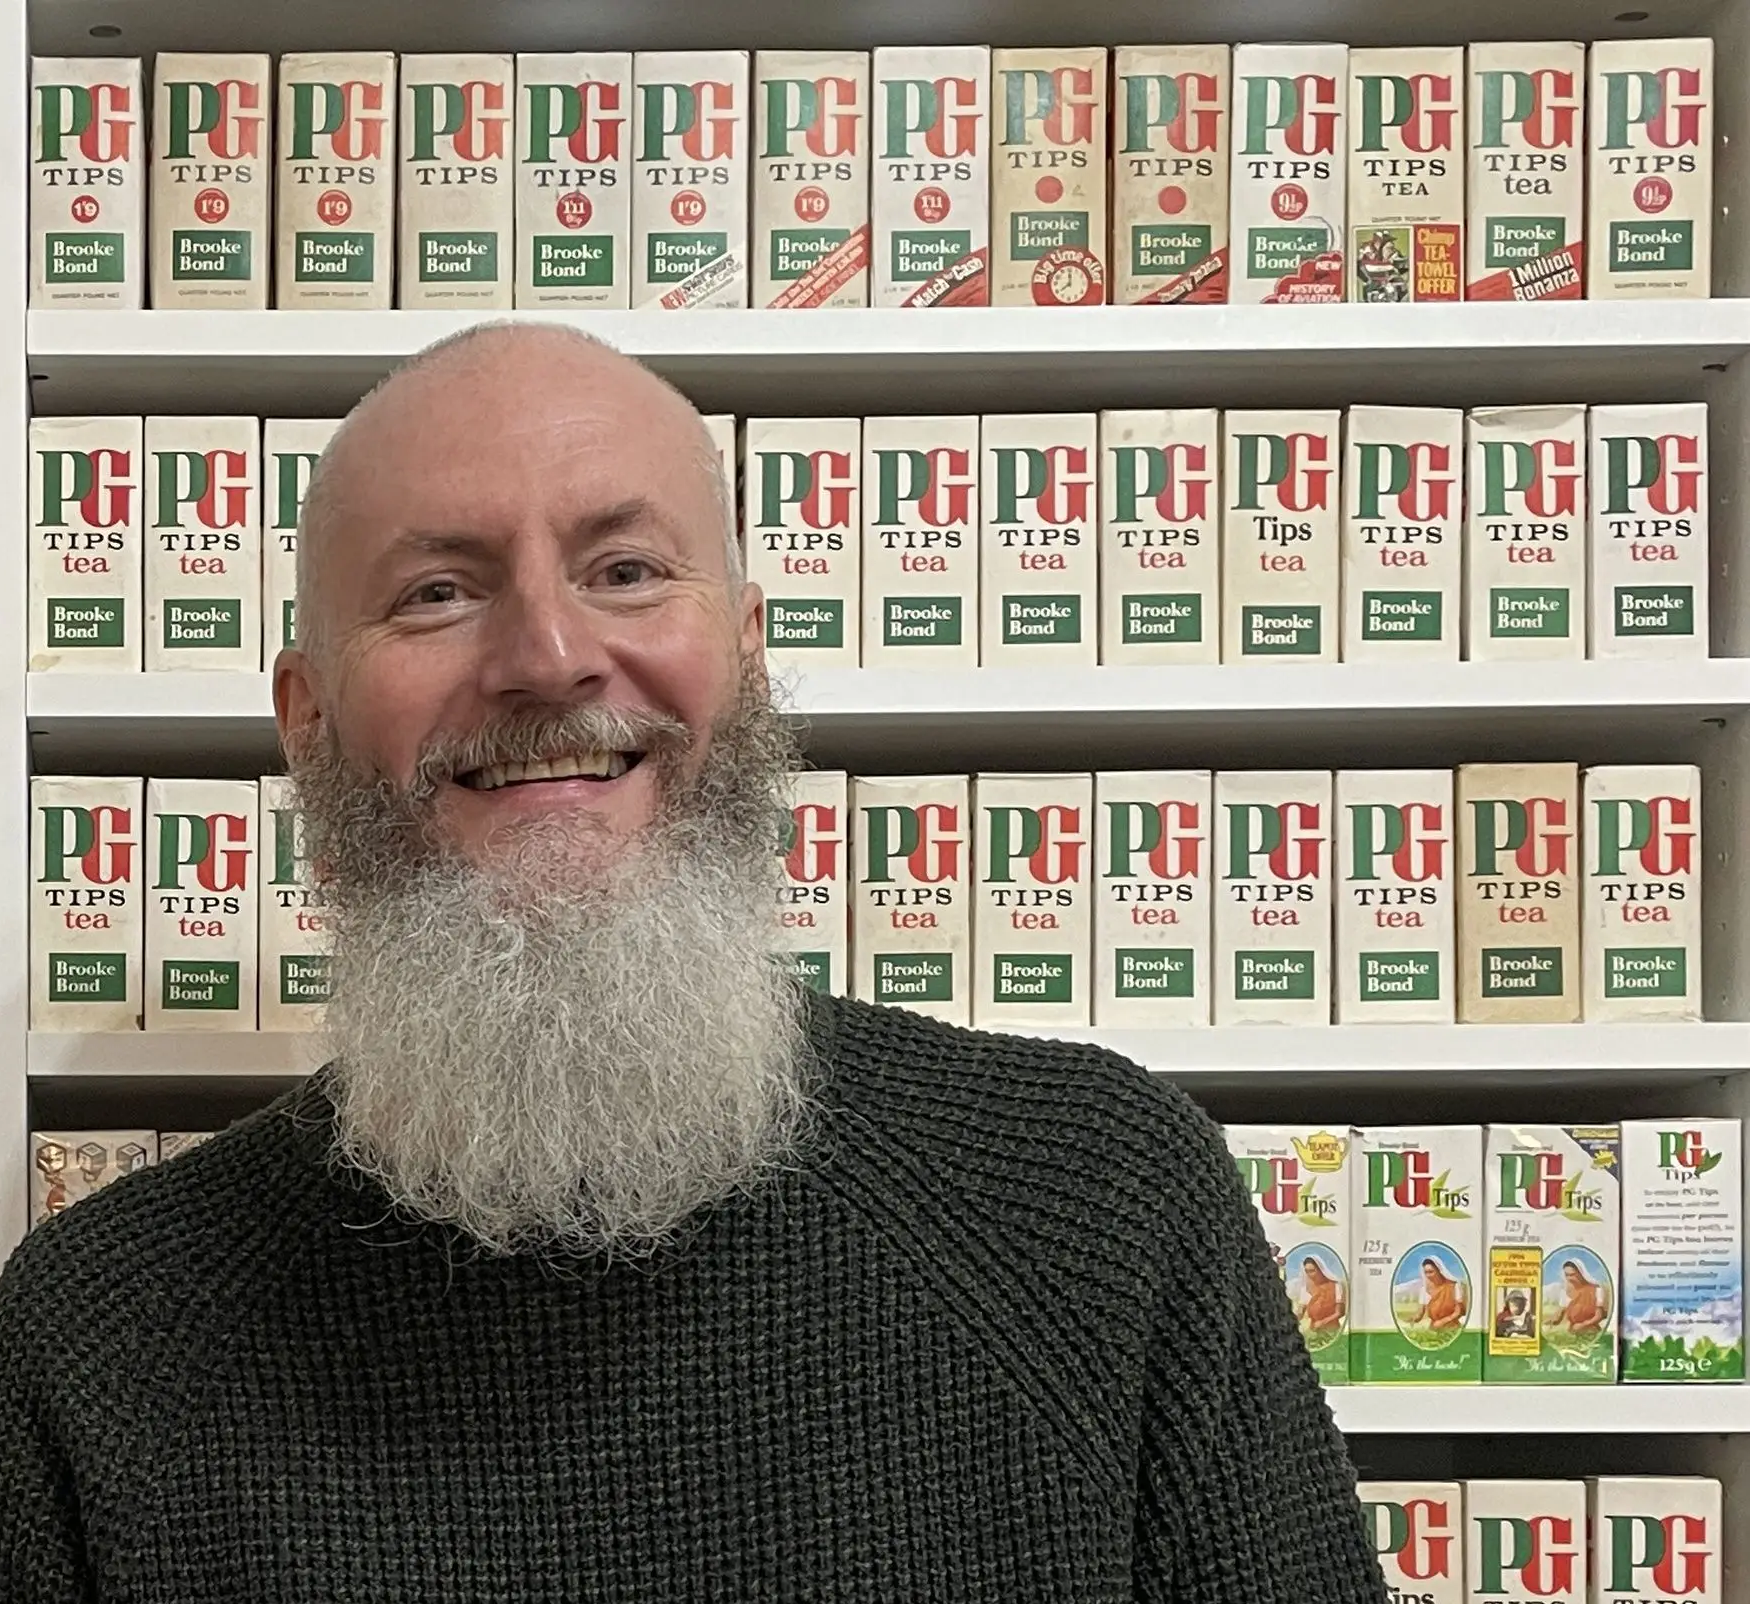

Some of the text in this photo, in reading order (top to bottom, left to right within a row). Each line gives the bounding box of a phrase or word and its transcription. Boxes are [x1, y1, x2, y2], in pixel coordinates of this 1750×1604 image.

[1382, 182, 1429, 198] TEA
[1503, 173, 1553, 196] tea
[1517, 252, 1573, 281] Million
[1514, 270, 1580, 302] Bonanza
[38, 450, 136, 528] PG
[1253, 515, 1312, 546] Tips
[1380, 546, 1429, 570] tea
[172, 606, 231, 624] Brooke
[46, 891, 126, 908] TIPS
[1487, 973, 1536, 990] Bond
[1432, 1189, 1470, 1211] Tips
[1658, 1358, 1695, 1374] 125g
[1474, 1516, 1578, 1595] PG
